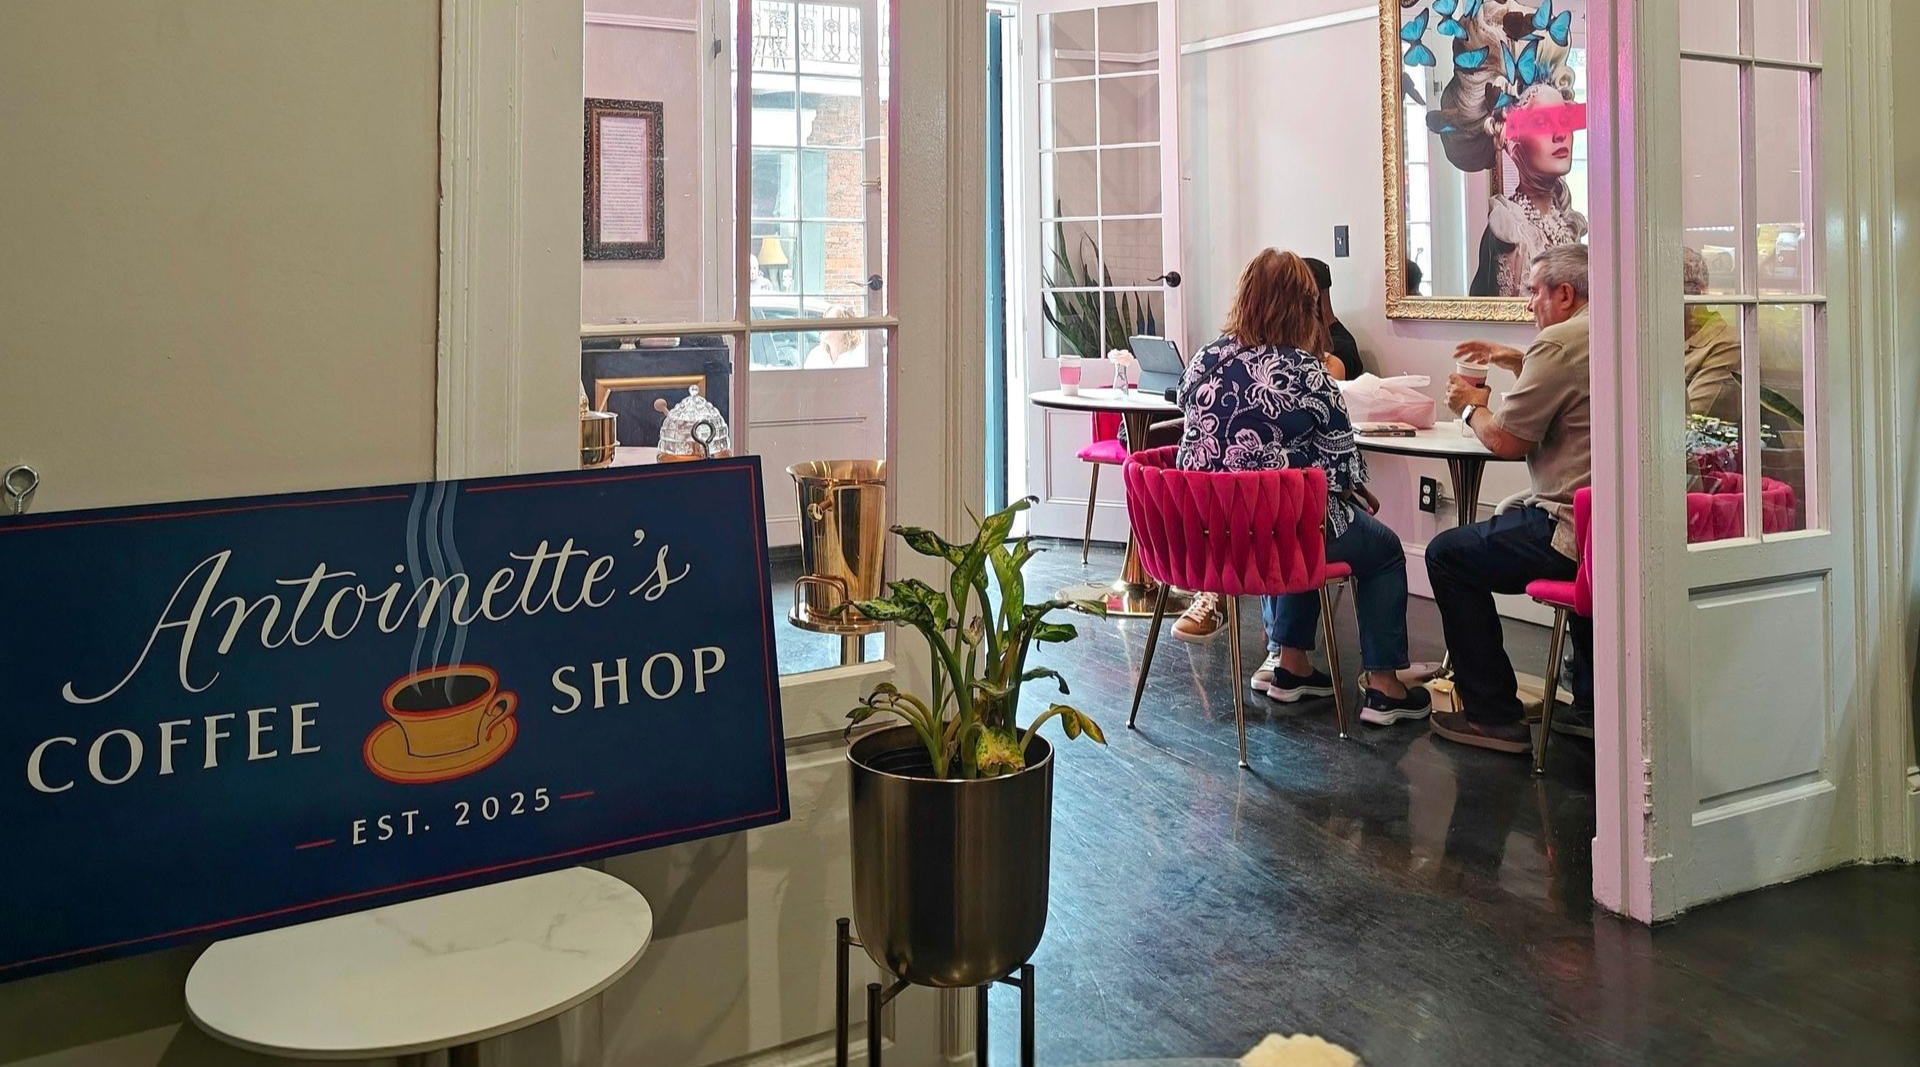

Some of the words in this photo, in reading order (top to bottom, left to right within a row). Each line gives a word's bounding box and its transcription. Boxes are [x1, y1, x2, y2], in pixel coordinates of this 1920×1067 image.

[63, 530, 690, 703] Antoinette's
[27, 702, 321, 793] COFFEE
[552, 646, 726, 714] SHOP
[353, 810, 430, 845] EST.
[455, 788, 550, 825] 2025
